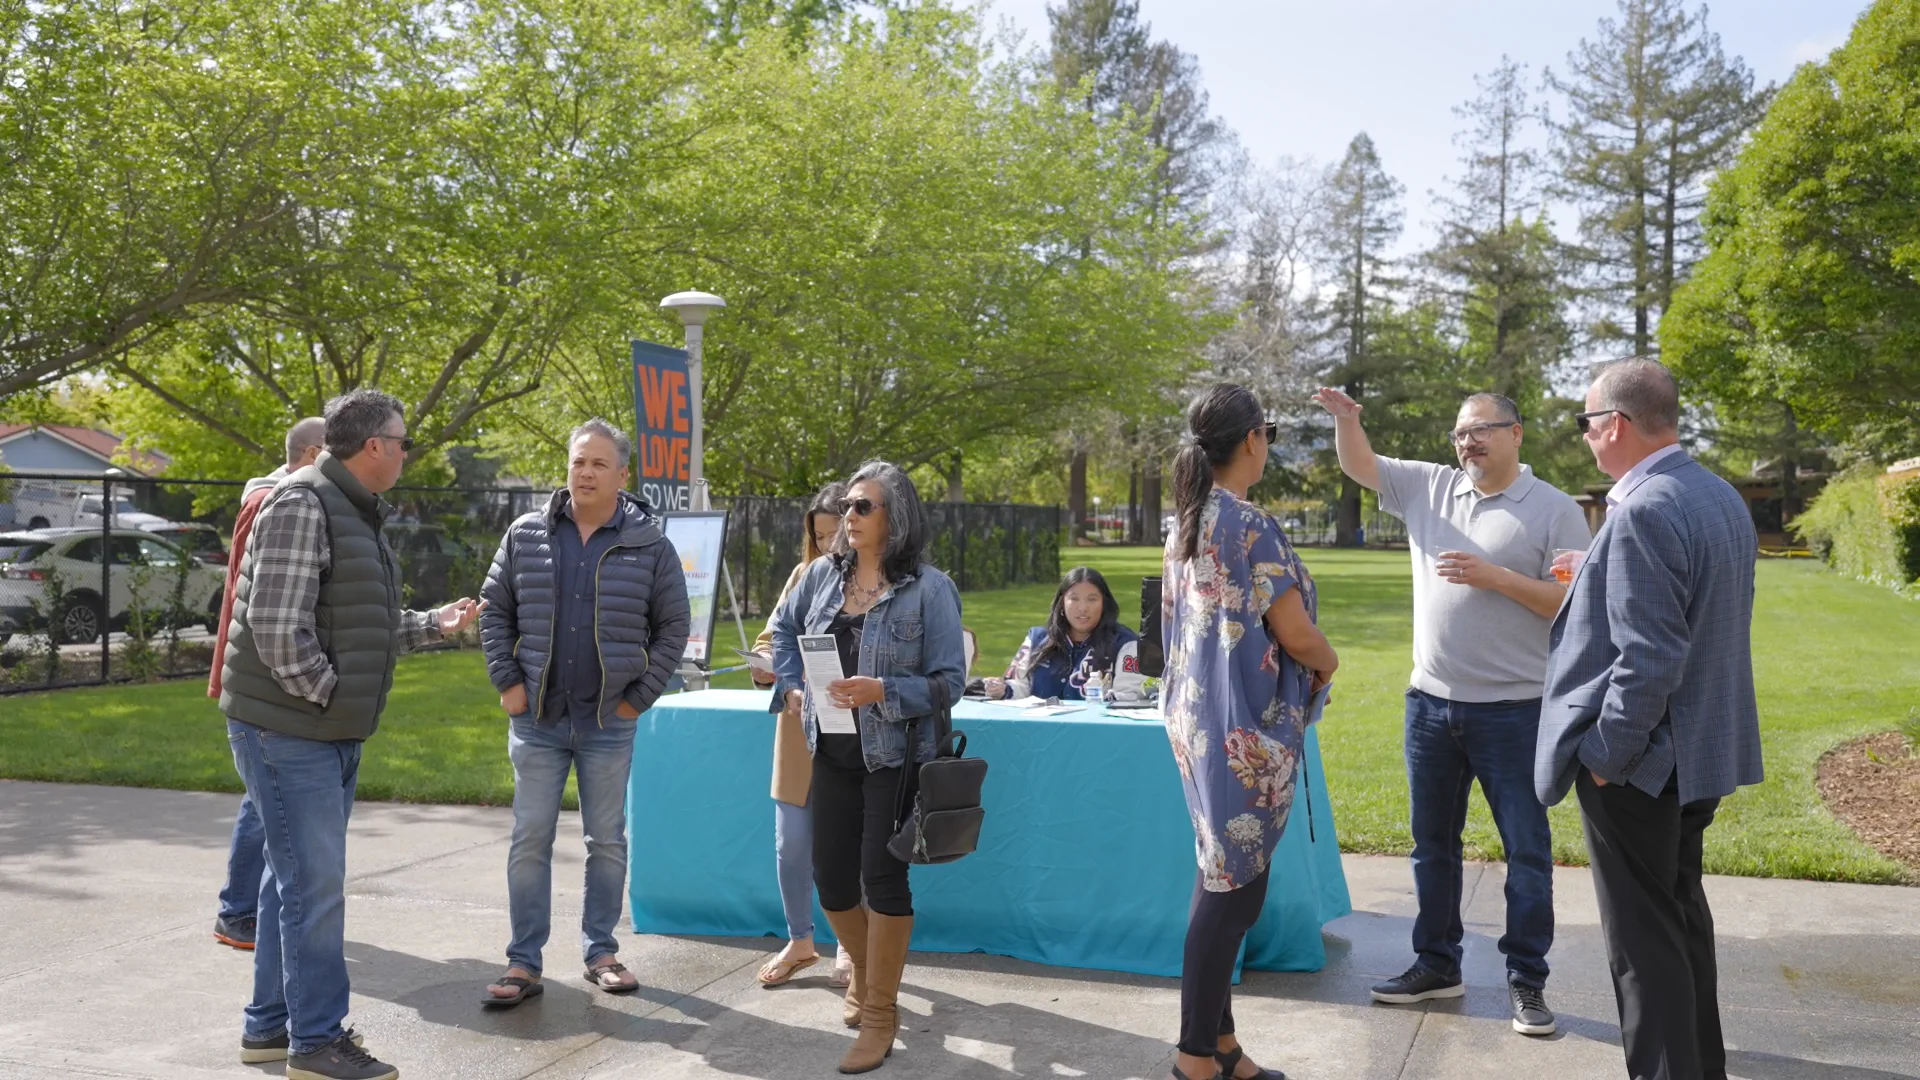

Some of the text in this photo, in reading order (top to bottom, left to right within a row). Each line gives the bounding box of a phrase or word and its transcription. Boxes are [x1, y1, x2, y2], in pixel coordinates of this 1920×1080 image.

[637, 364, 689, 432] WE
[640, 432, 689, 480] LOVE
[642, 483, 689, 511] SO WE
